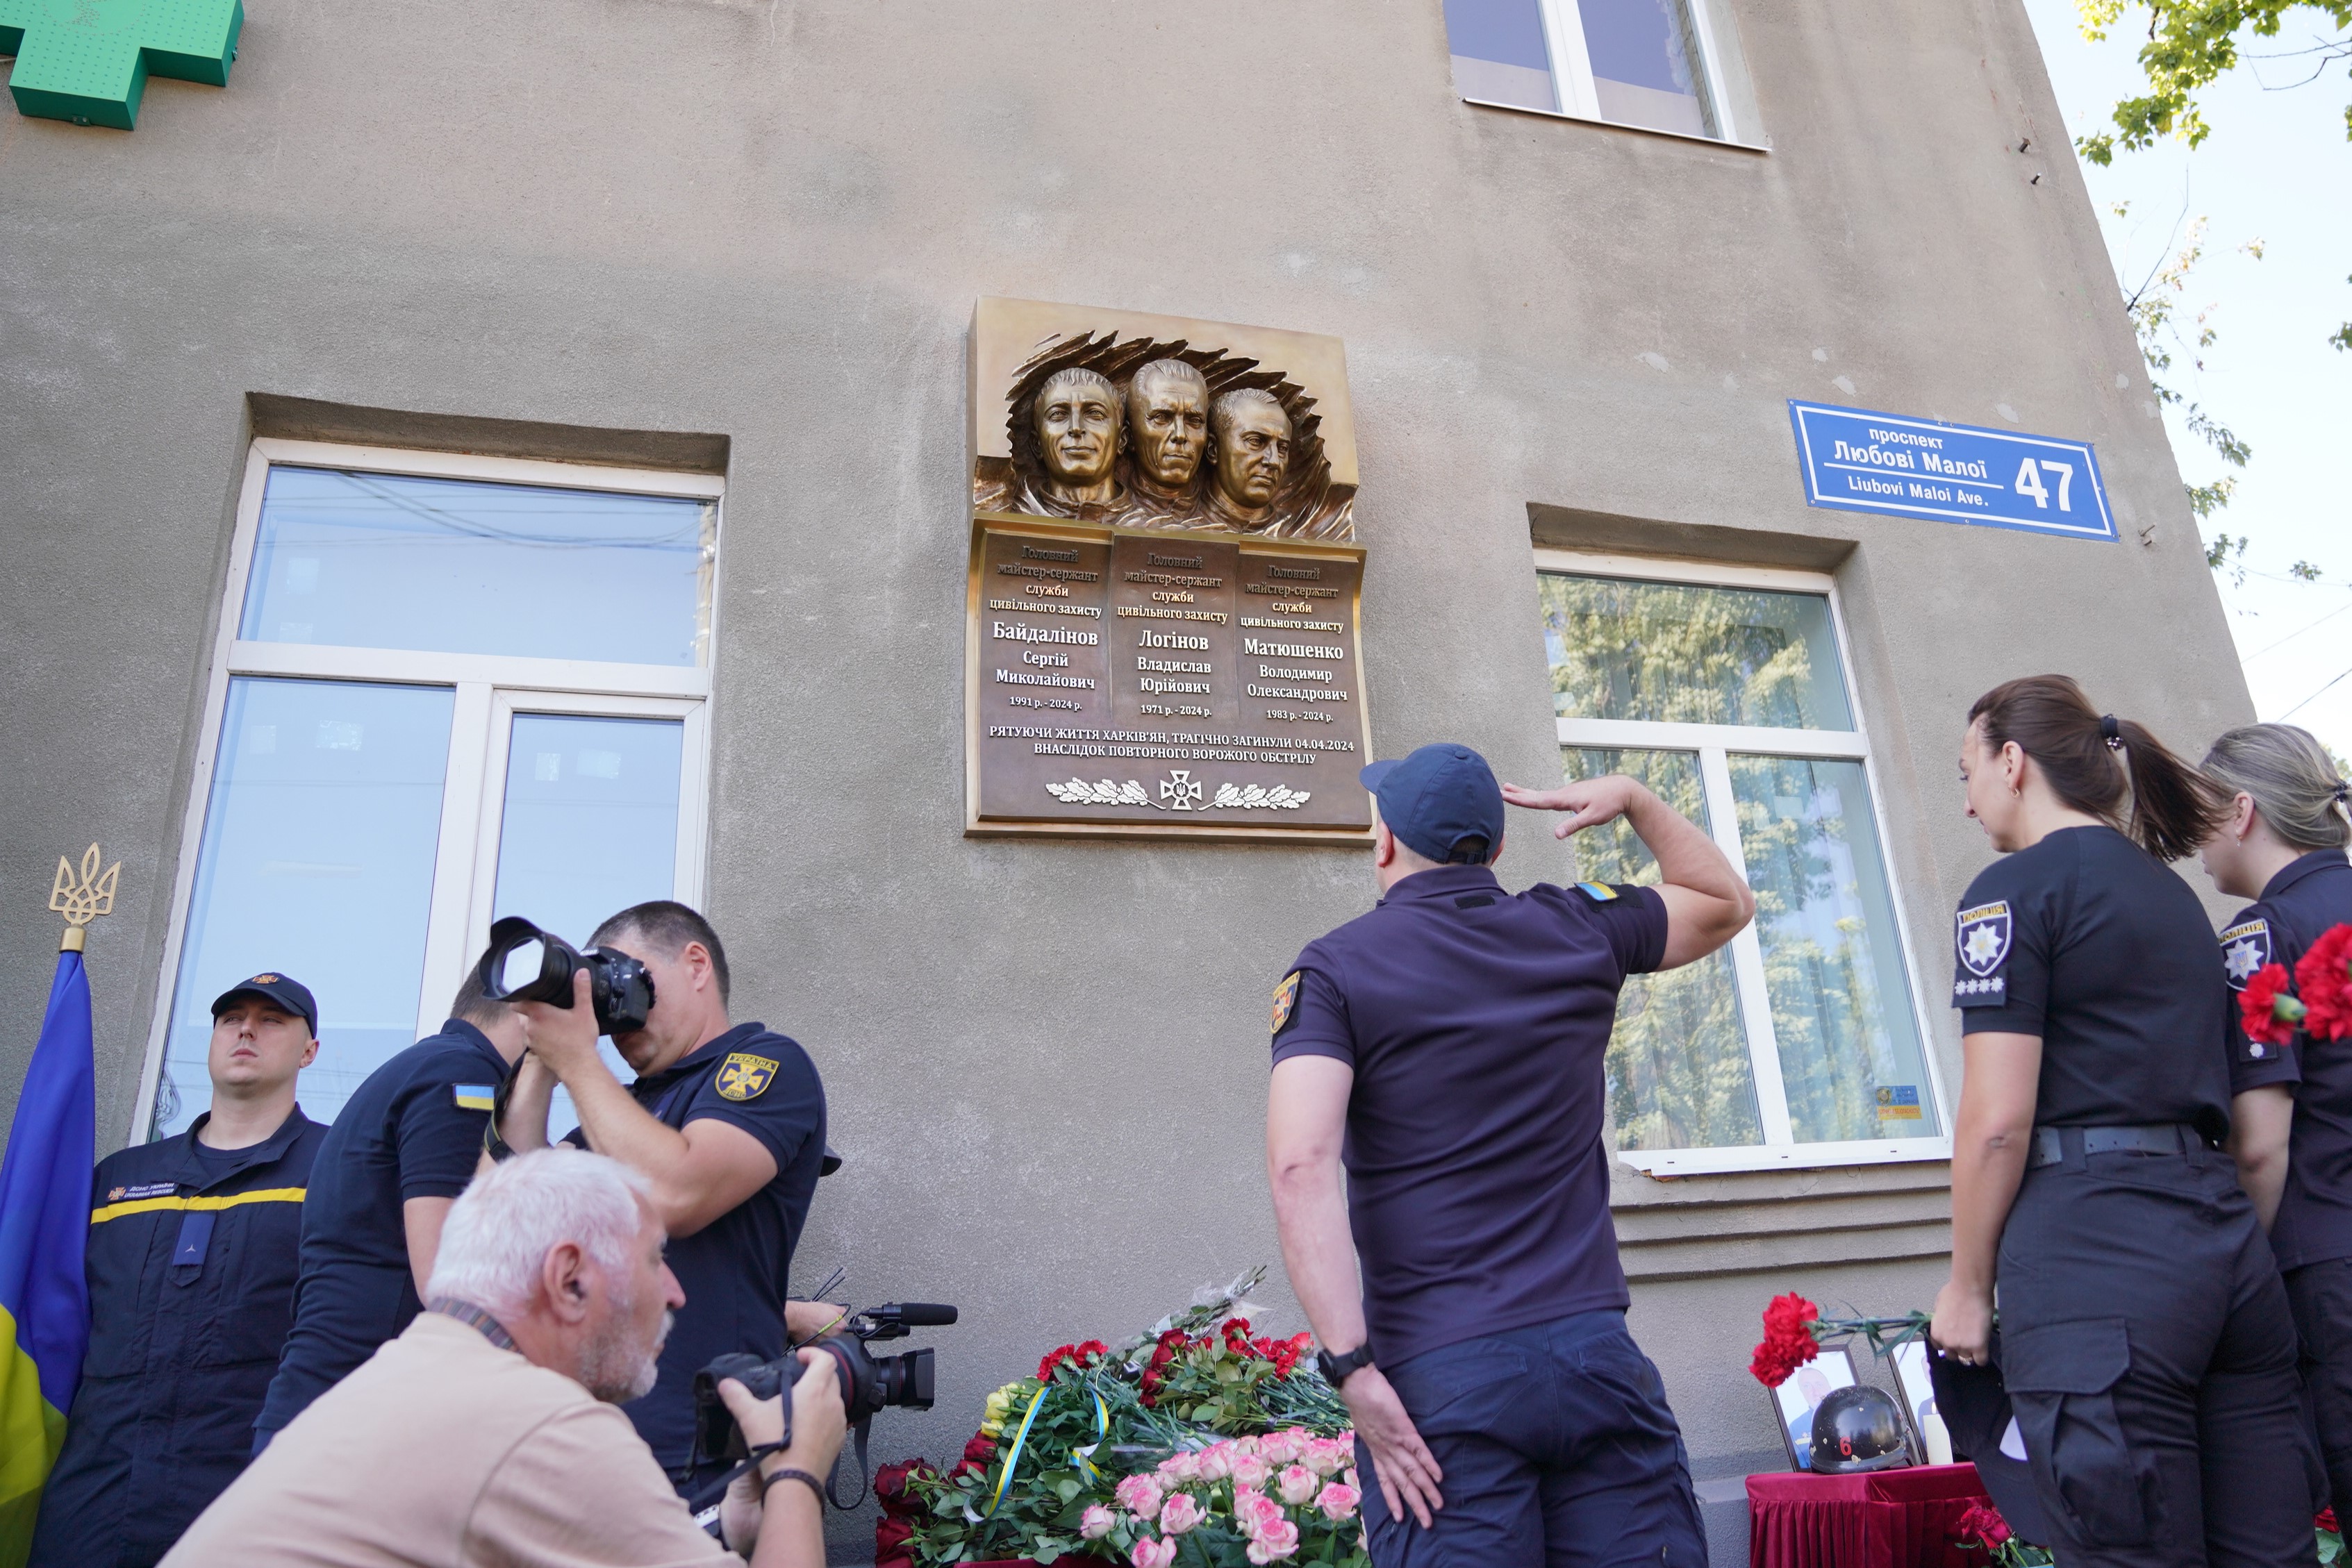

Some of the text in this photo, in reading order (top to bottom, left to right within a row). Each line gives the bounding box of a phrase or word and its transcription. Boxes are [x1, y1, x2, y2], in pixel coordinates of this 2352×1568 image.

[1869, 428, 1943, 450] проспект
[1835, 440, 1988, 479] Любові Малої
[1848, 476, 1989, 506] Liubovi Maloi Ave.
[2015, 457, 2073, 512] 47
[1022, 546, 1078, 562] Головний
[1148, 553, 1202, 569] Головний
[997, 562, 1098, 582] майстер-сержант
[1124, 570, 1223, 589] майстер-сержант
[1268, 565, 1320, 581] Головний
[1026, 584, 1068, 597] служби
[1152, 591, 1194, 604] служби
[1245, 582, 1339, 599] майстер-сержант
[990, 599, 1102, 619] цивільного захисту
[1117, 605, 1228, 624] цивільного захисту
[1273, 601, 1312, 615] служби
[993, 622, 1098, 646] Байдалінов
[1241, 616, 1344, 634] цивільного захисту
[1138, 630, 1209, 650] Логінов
[1244, 638, 1343, 660] Матюшенко
[1023, 651, 1068, 668] Сергій
[1137, 656, 1211, 674] Владислав
[996, 669, 1095, 690] Миколайович
[1259, 665, 1332, 684] Володимир
[1140, 678, 1211, 696] Юрійович
[1248, 684, 1348, 702] Олександрович
[1010, 697, 1032, 707] 1991
[1034, 700, 1043, 709] р.
[1050, 699, 1073, 709] 2024
[1074, 701, 1082, 711] р.
[1141, 704, 1163, 715] 1971
[1165, 707, 1173, 717] р.
[1180, 706, 1202, 716] 2024
[1204, 708, 1212, 718] р.
[1266, 710, 1288, 719] 1983
[1289, 712, 1297, 722] р.
[1303, 711, 1323, 722] 2024
[1325, 714, 1334, 723] р.
[989, 726, 1052, 740] РЯТУЮЧИ
[1055, 728, 1100, 741] ЖИТТЯ
[1172, 733, 1229, 746] ТРАГІЧНО
[1232, 736, 1292, 749] ЗАГИНУЛИ
[1295, 739, 1355, 751] 04.04.2024
[1034, 743, 1316, 765] ВНАСЛІДОК ПОВТОРНОГО ВОРОЖОГО ОБСТРІЛУ
[1962, 905, 2004, 923] ПОЛІЦІЯ
[733, 1055, 772, 1069] УКРАЇНА
[1839, 1437, 1852, 1456] 6
